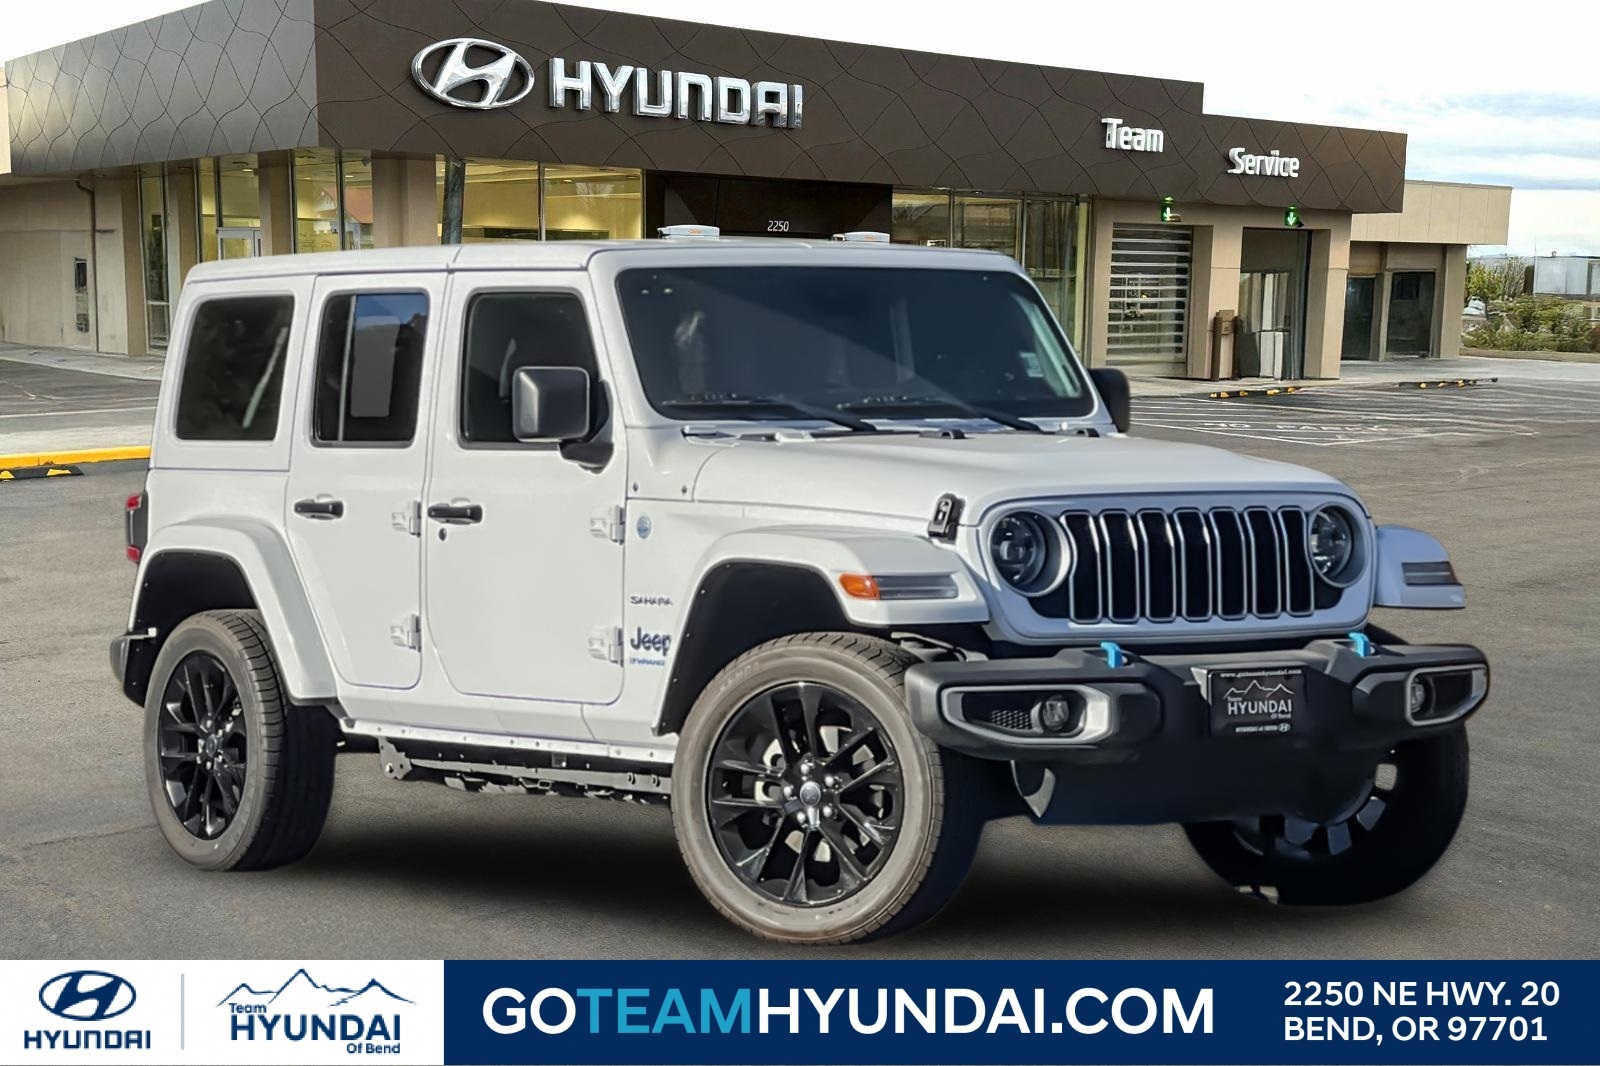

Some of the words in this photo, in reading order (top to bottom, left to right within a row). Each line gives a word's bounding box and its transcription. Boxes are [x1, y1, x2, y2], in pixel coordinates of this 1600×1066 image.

[549, 57, 803, 129] HYUNDAI
[1101, 117, 1165, 153] Team
[1227, 146, 1300, 178] Service
[767, 220, 790, 232] 2250
[630, 626, 672, 656] Jeep
[1227, 699, 1292, 716] HYUNDAI
